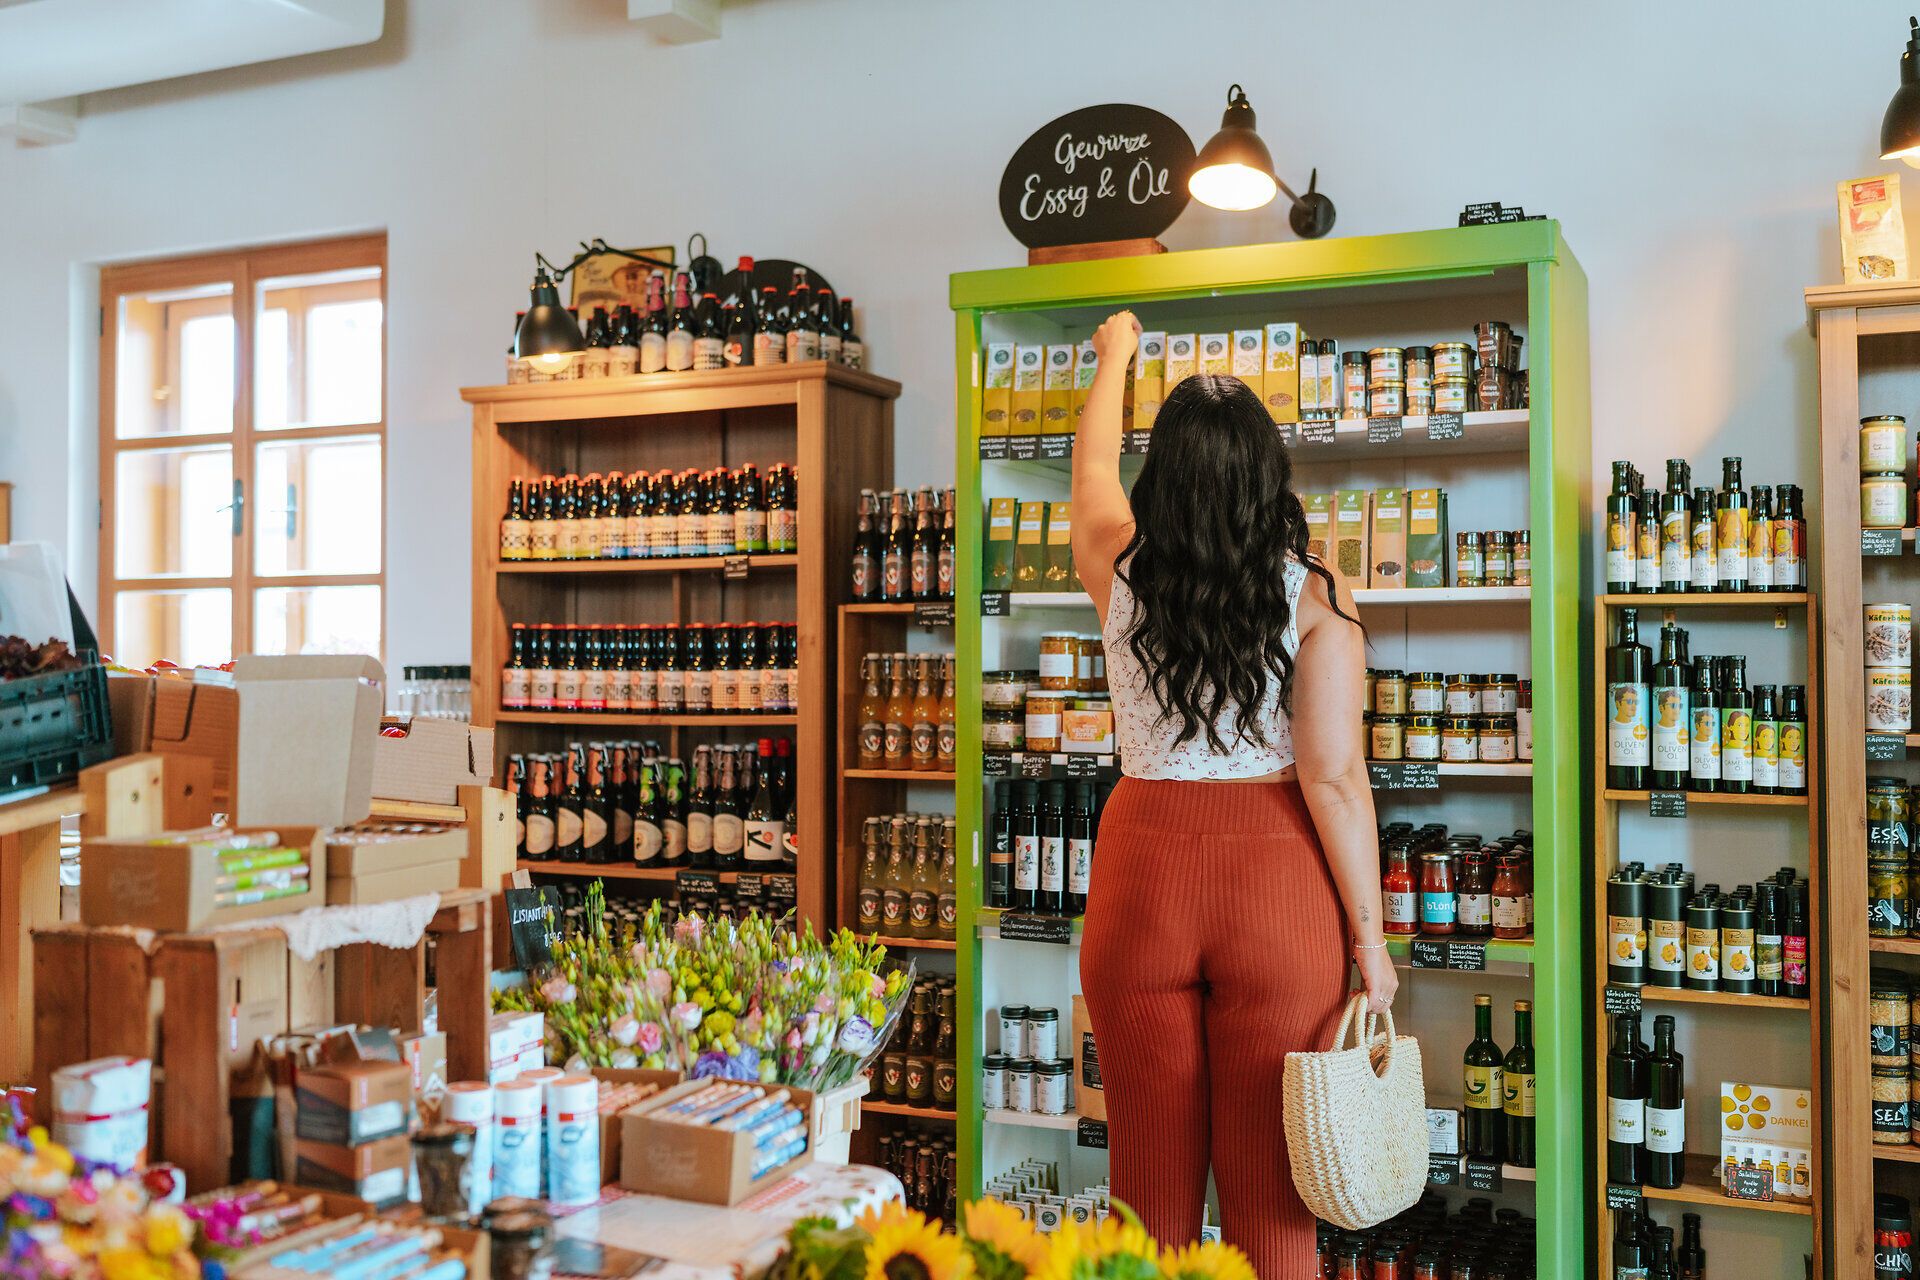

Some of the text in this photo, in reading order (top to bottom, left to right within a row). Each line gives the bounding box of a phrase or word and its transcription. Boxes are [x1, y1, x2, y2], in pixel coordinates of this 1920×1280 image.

[1055, 132, 1151, 174] Gewürze
[1019, 157, 1171, 221] Essig & Öl
[1614, 740, 1645, 749] OLIVEN
[1658, 745, 1687, 753] OLIVEN
[1871, 826, 1900, 841] ESS
[1388, 895, 1403, 907] Sal
[513, 904, 553, 925] LISIANTH
[1390, 907, 1402, 916] sa
[1415, 942, 1438, 954] Ketchup
[1770, 1115, 1809, 1128] DANKE!
[1874, 1108, 1903, 1122] SEL
[1433, 1171, 1450, 1182] 2,30
[1875, 1253, 1901, 1268] CHI
